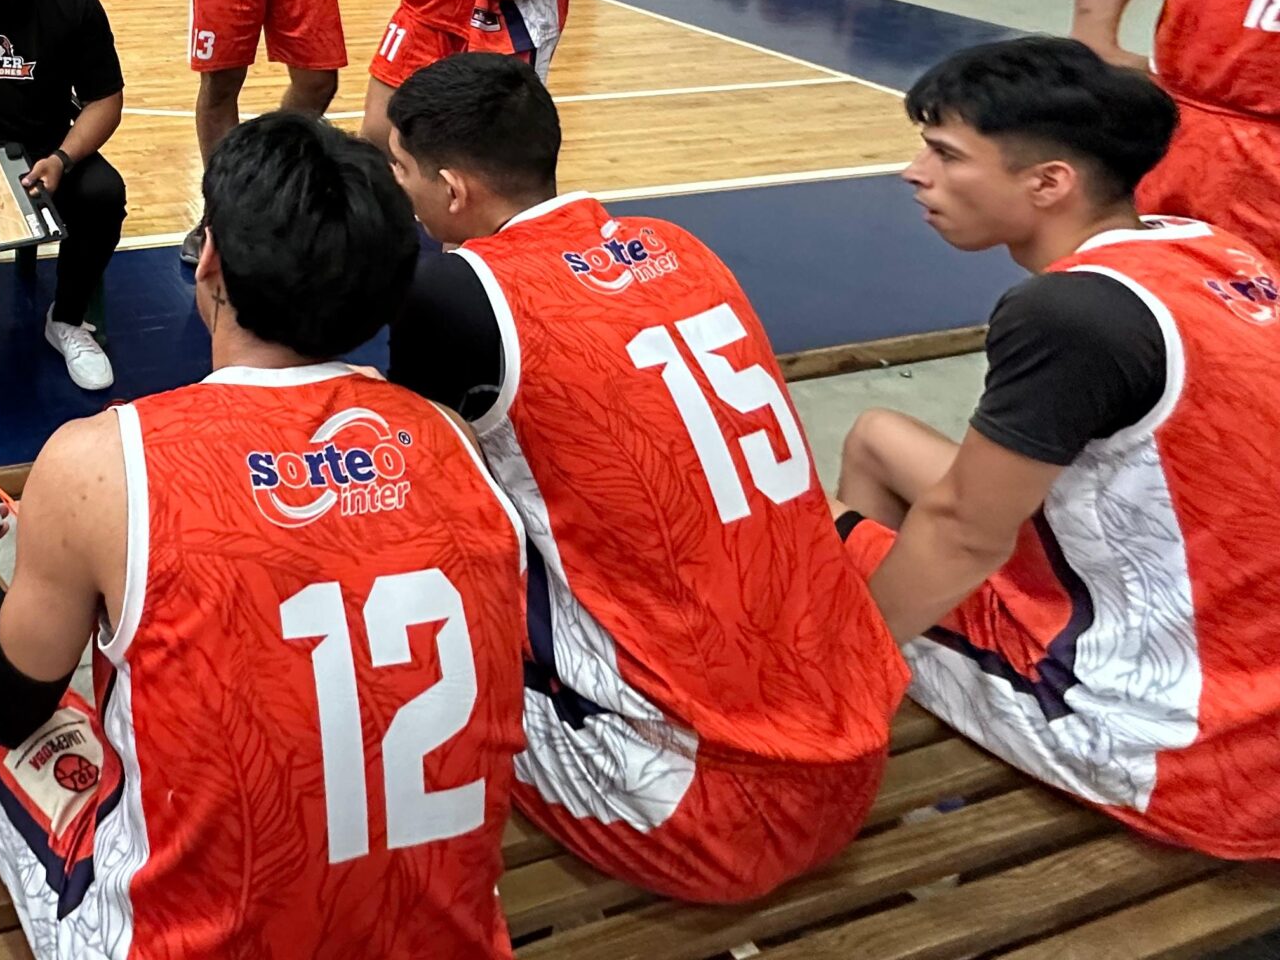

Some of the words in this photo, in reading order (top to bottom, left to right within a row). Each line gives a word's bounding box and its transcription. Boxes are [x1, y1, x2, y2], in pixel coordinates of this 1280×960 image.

[378, 23, 406, 62] 11
[631, 250, 679, 283] inter
[625, 303, 811, 525] 15
[247, 442, 405, 489] sorteo
[339, 480, 411, 516] inter
[279, 567, 485, 865] 12
